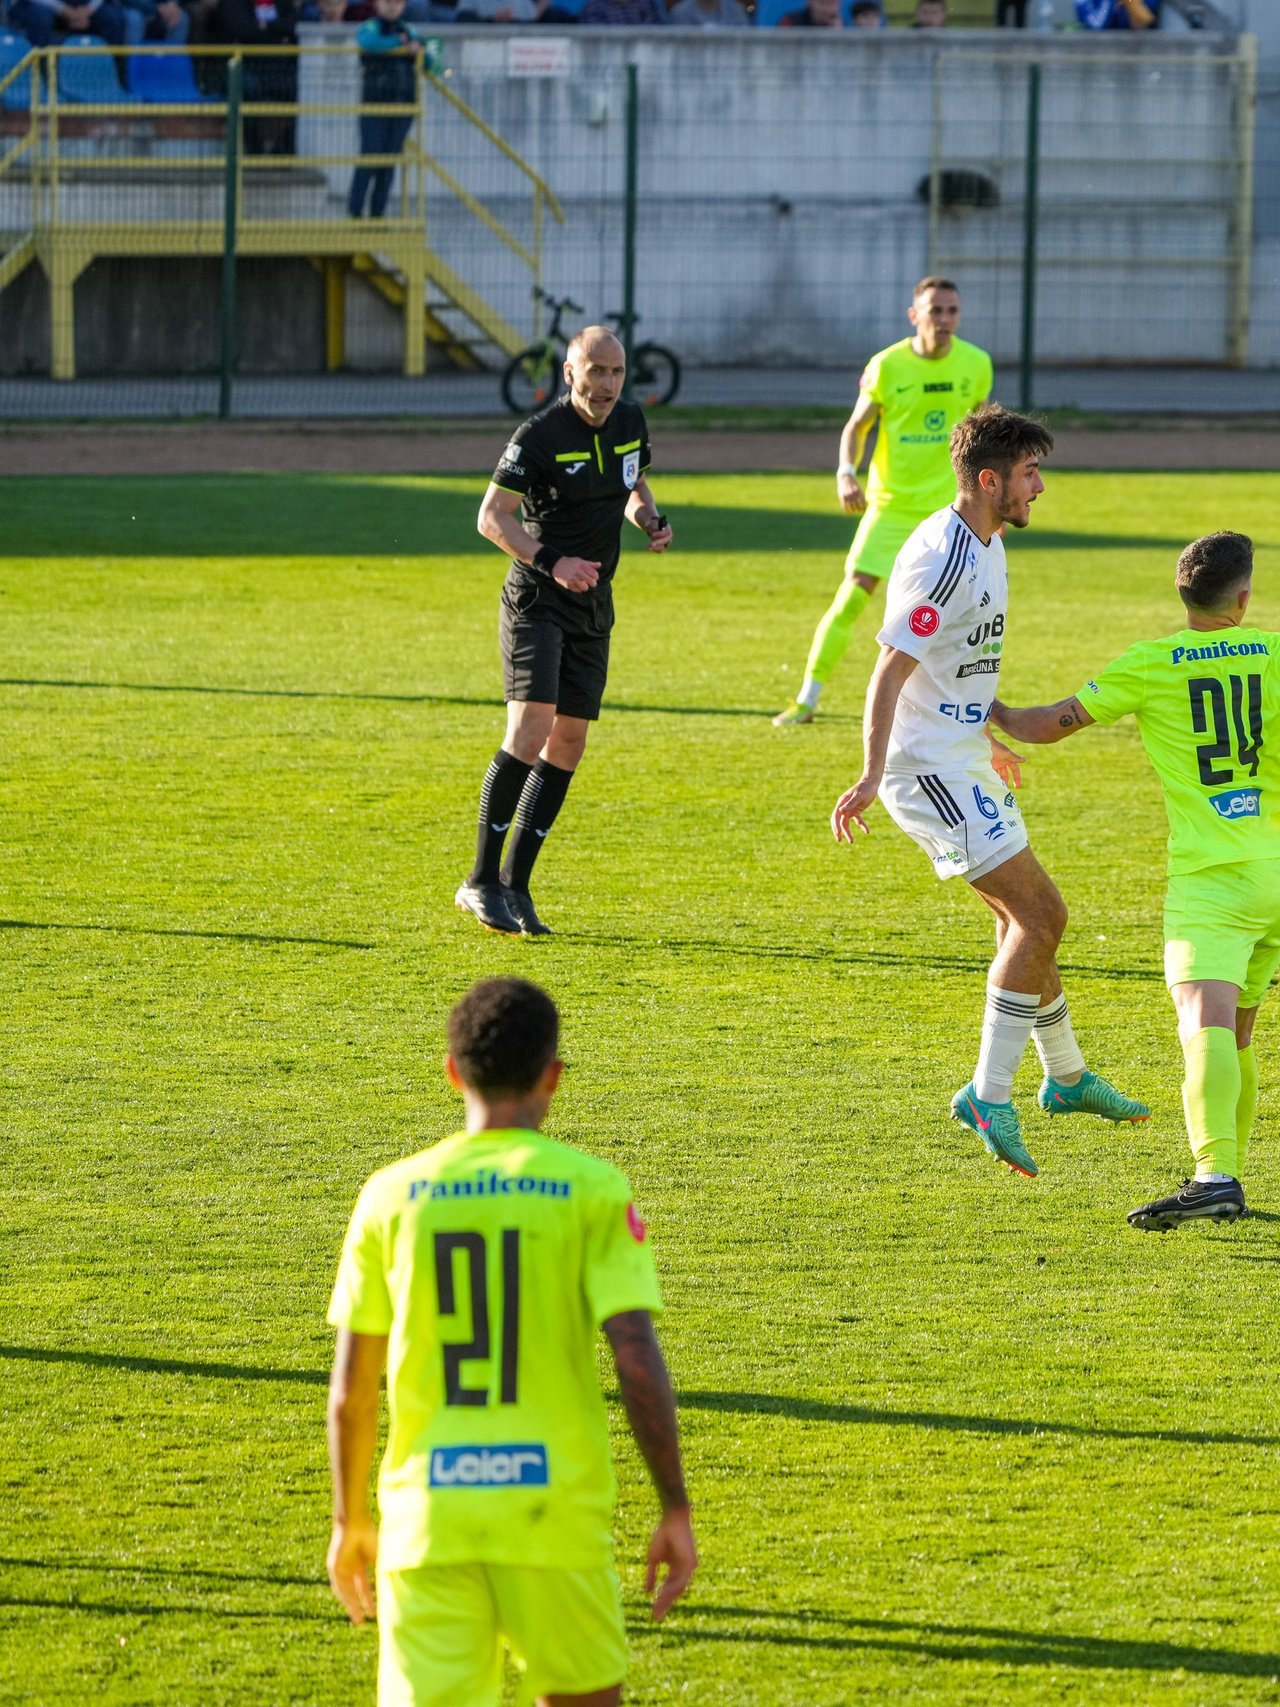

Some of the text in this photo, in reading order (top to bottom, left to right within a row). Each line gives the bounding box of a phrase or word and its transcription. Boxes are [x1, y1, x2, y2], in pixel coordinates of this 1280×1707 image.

[1171, 641, 1270, 665] Panifcom
[1188, 674, 1264, 786] 24
[972, 784, 999, 820] 6
[409, 1168, 571, 1200] Panifcom
[433, 1229, 520, 1406] 21
